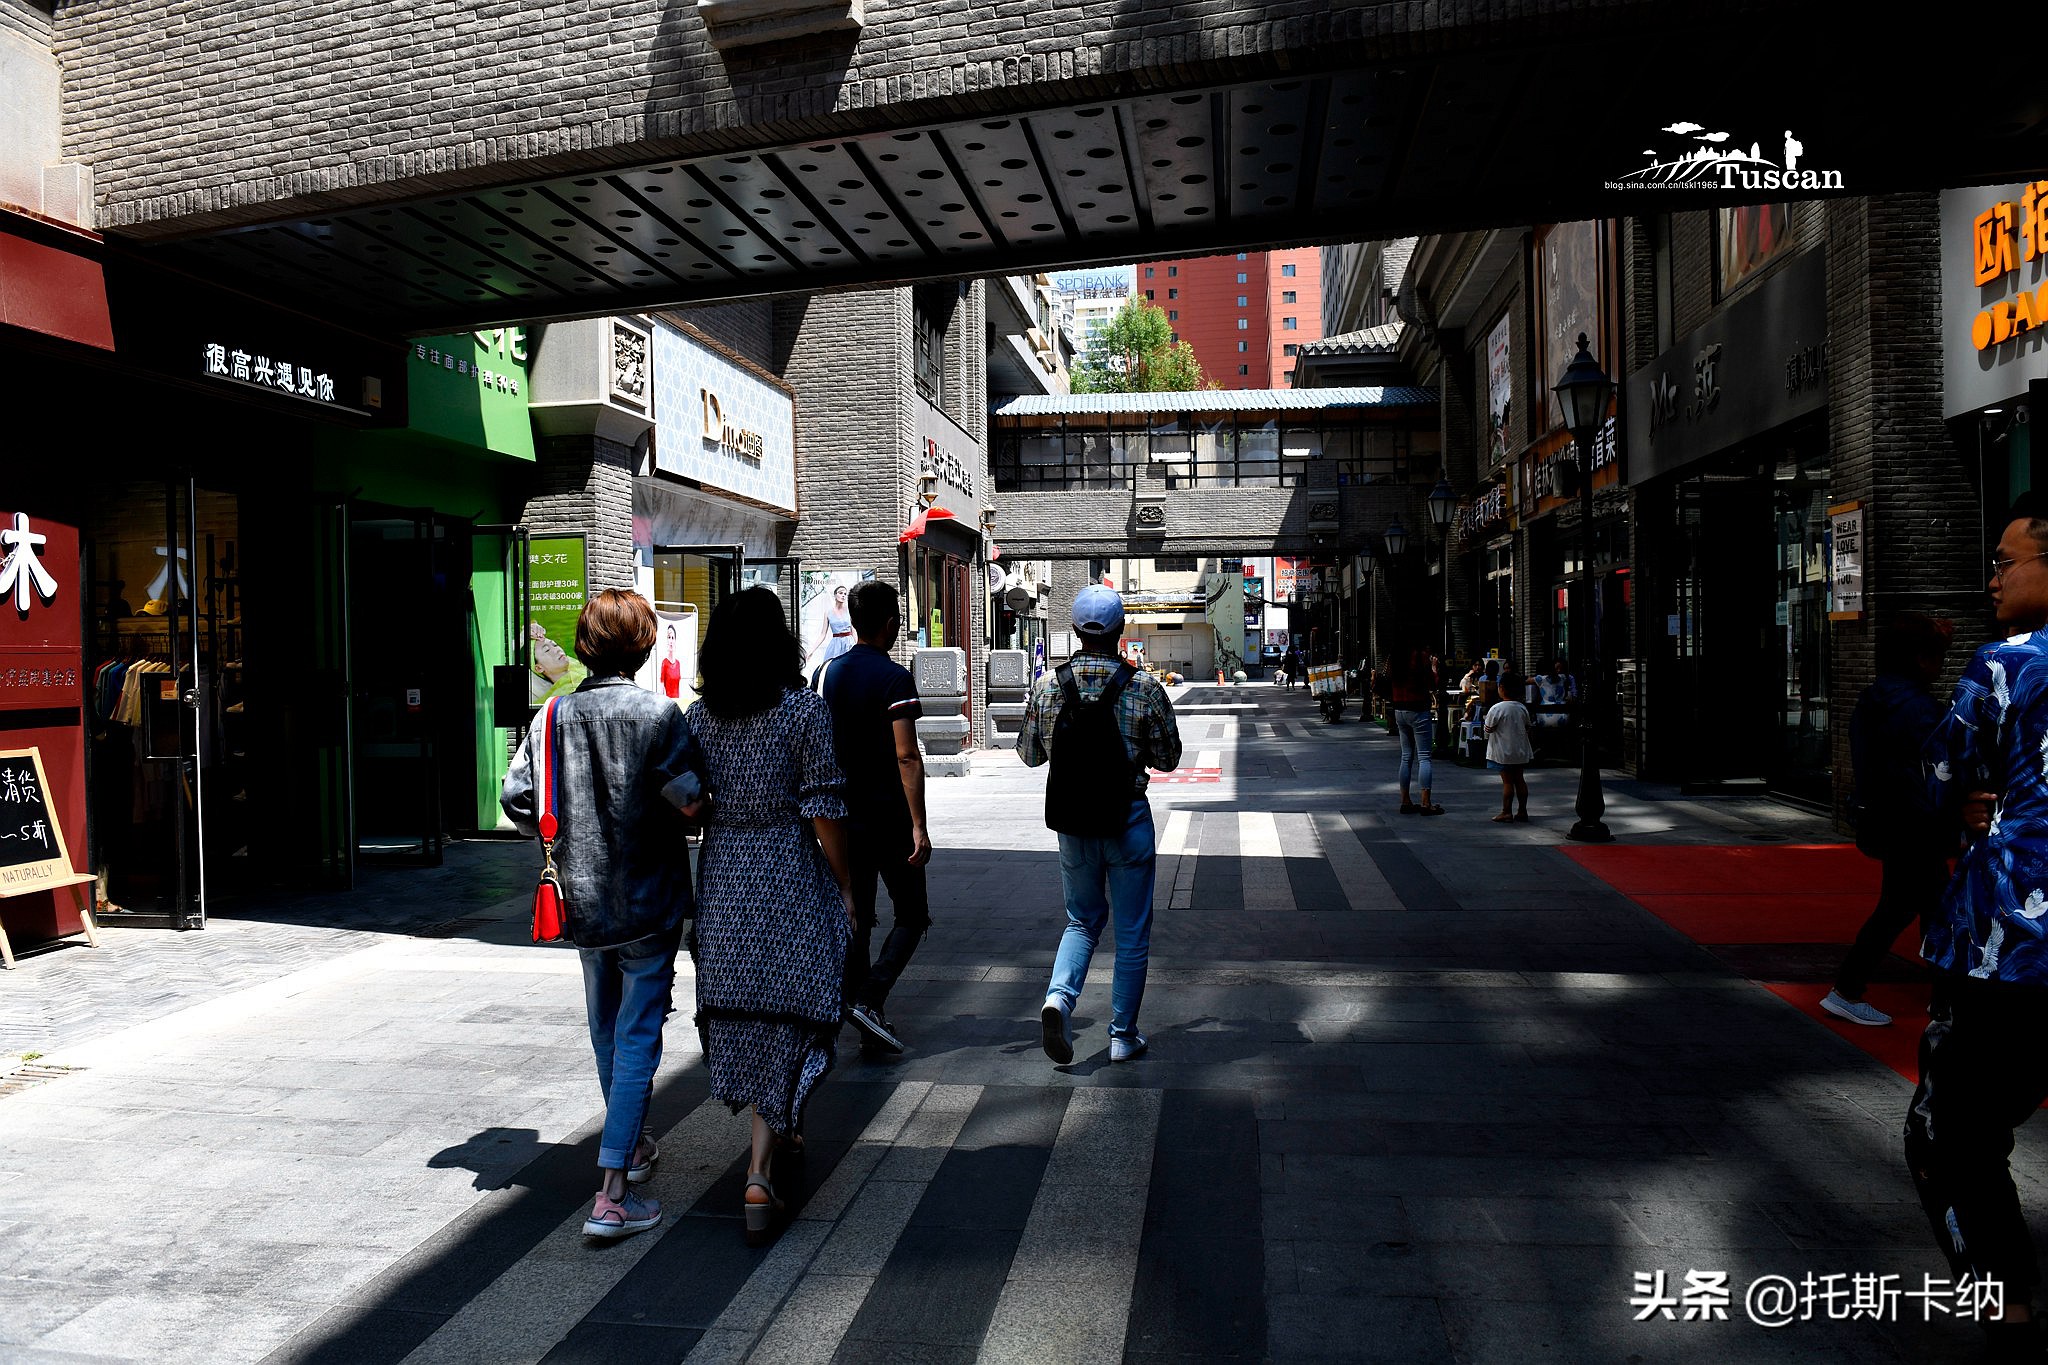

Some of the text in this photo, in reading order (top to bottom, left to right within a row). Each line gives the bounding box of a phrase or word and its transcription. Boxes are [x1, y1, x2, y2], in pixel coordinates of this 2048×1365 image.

[1086, 275, 1124, 288] BANK
[204, 343, 335, 401] 很高兴遇见你
[1836, 520, 1857, 534] WEAR
[1836, 539, 1856, 552] LOVE
[0, 511, 58, 612] 木
[0, 767, 41, 804] 清货
[2, 864, 53, 884] NATURALLY
